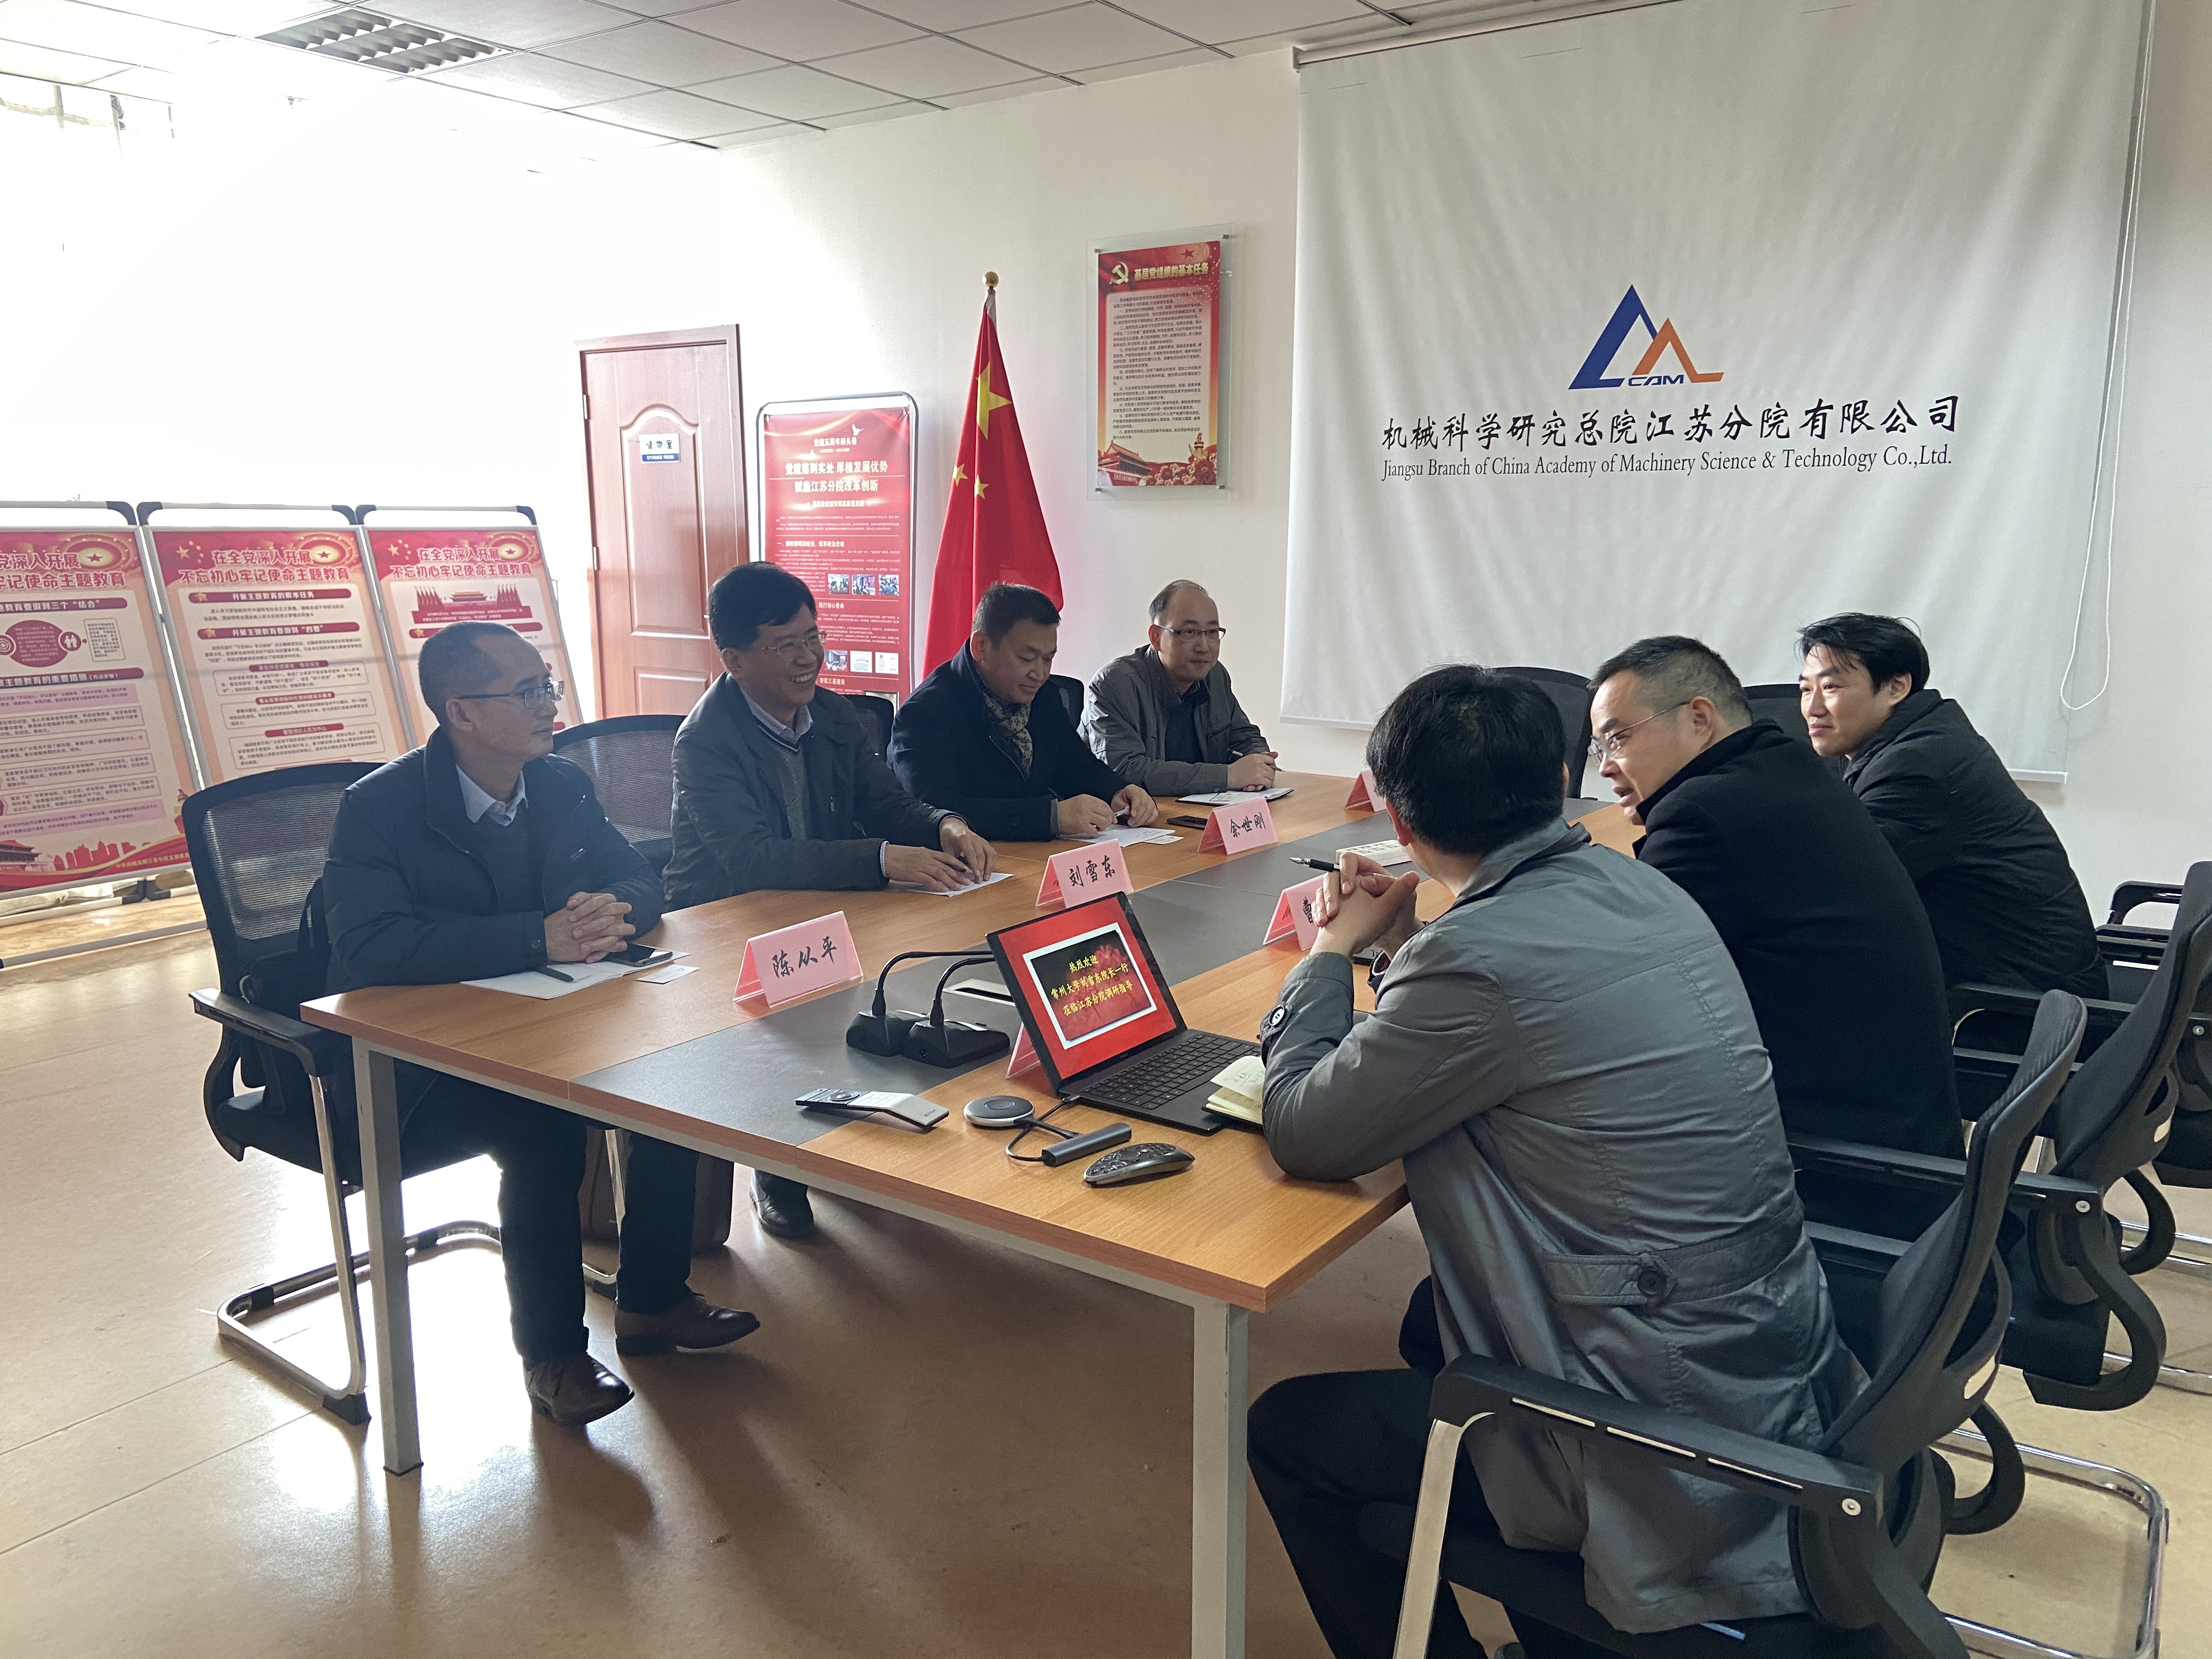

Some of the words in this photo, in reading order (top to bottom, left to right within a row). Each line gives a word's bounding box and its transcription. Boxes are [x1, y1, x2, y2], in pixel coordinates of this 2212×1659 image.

[1134, 262, 1209, 281] 基层党组织的基本任务
[1628, 375, 1684, 386] CAM
[1381, 395, 1959, 452] 机械科学研究总院江苏分院有限公司
[785, 462, 834, 475] 党建落到实处
[836, 460, 888, 474] 厚植发展优势
[1381, 460, 1423, 481] Jiangsu
[1428, 458, 1470, 476] Branch
[1475, 456, 1488, 475] of
[1492, 456, 1530, 474] China
[1534, 454, 1596, 478] Academy
[1601, 453, 1618, 472] of
[1620, 453, 1695, 476] Machinery
[1701, 451, 1757, 471] Science
[1762, 451, 1776, 469] &
[1782, 447, 1877, 472] Technology
[794, 479, 878, 493] 赋能江苏分院改革创新
[211, 549, 314, 566] 在全党深入开展
[417, 546, 501, 561] 在全党深入开展
[178, 566, 350, 583] 不忘初心牢记使命主题教育
[390, 562, 532, 579] 不忘初心牢记使命主题教育
[1069, 855, 1115, 887] 刘雪东
[772, 935, 837, 978] 陈从平
[1069, 955, 1099, 973] 热烈欢迎
[1051, 962, 1129, 1000] 常州大学刘雪东院长一行
[1063, 980, 1133, 1017] 莅临江苏分院调研指导
